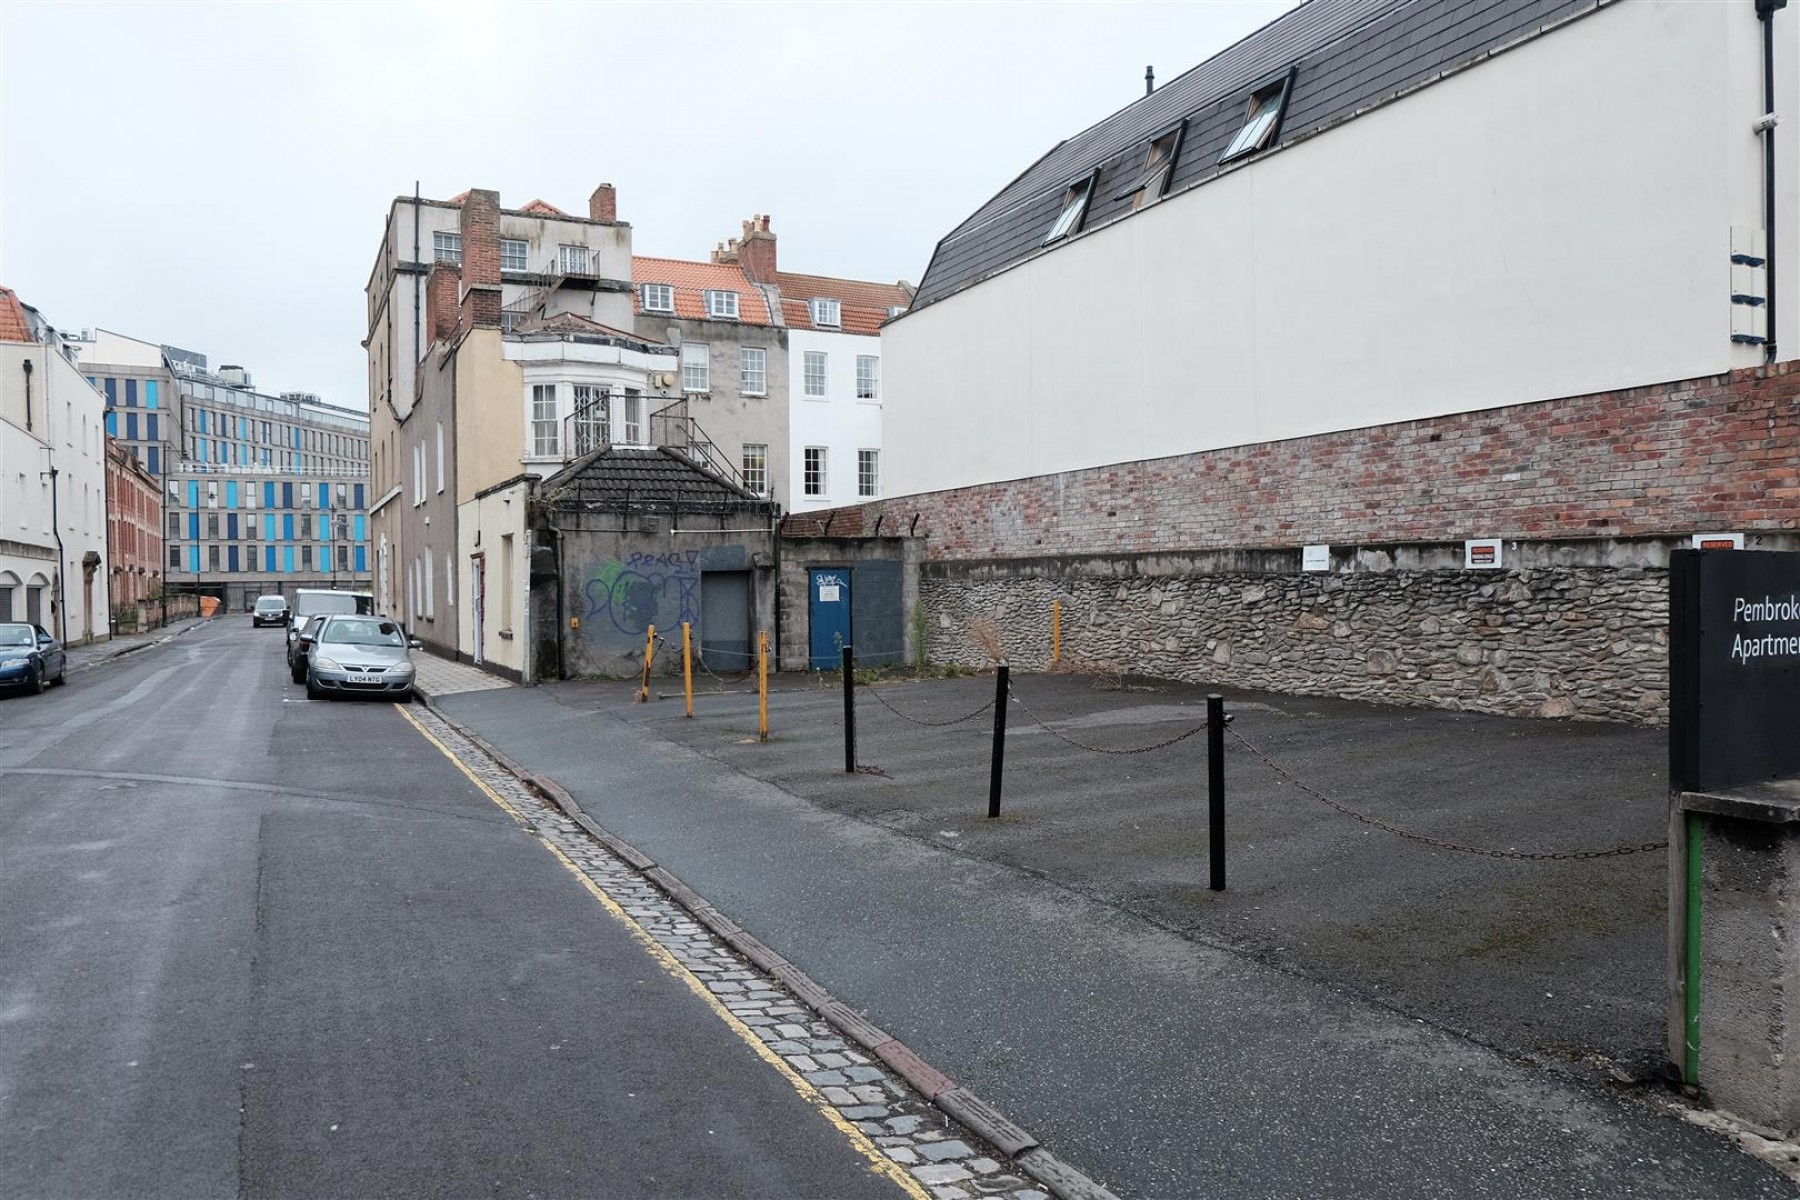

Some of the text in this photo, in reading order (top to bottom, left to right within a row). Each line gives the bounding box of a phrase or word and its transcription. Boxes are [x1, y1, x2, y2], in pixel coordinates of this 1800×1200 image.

[1511, 542, 1517, 550] 3
[1755, 536, 1762, 545] 2
[1733, 594, 1800, 622] Pembrok
[1731, 633, 1800, 666] Apartme
